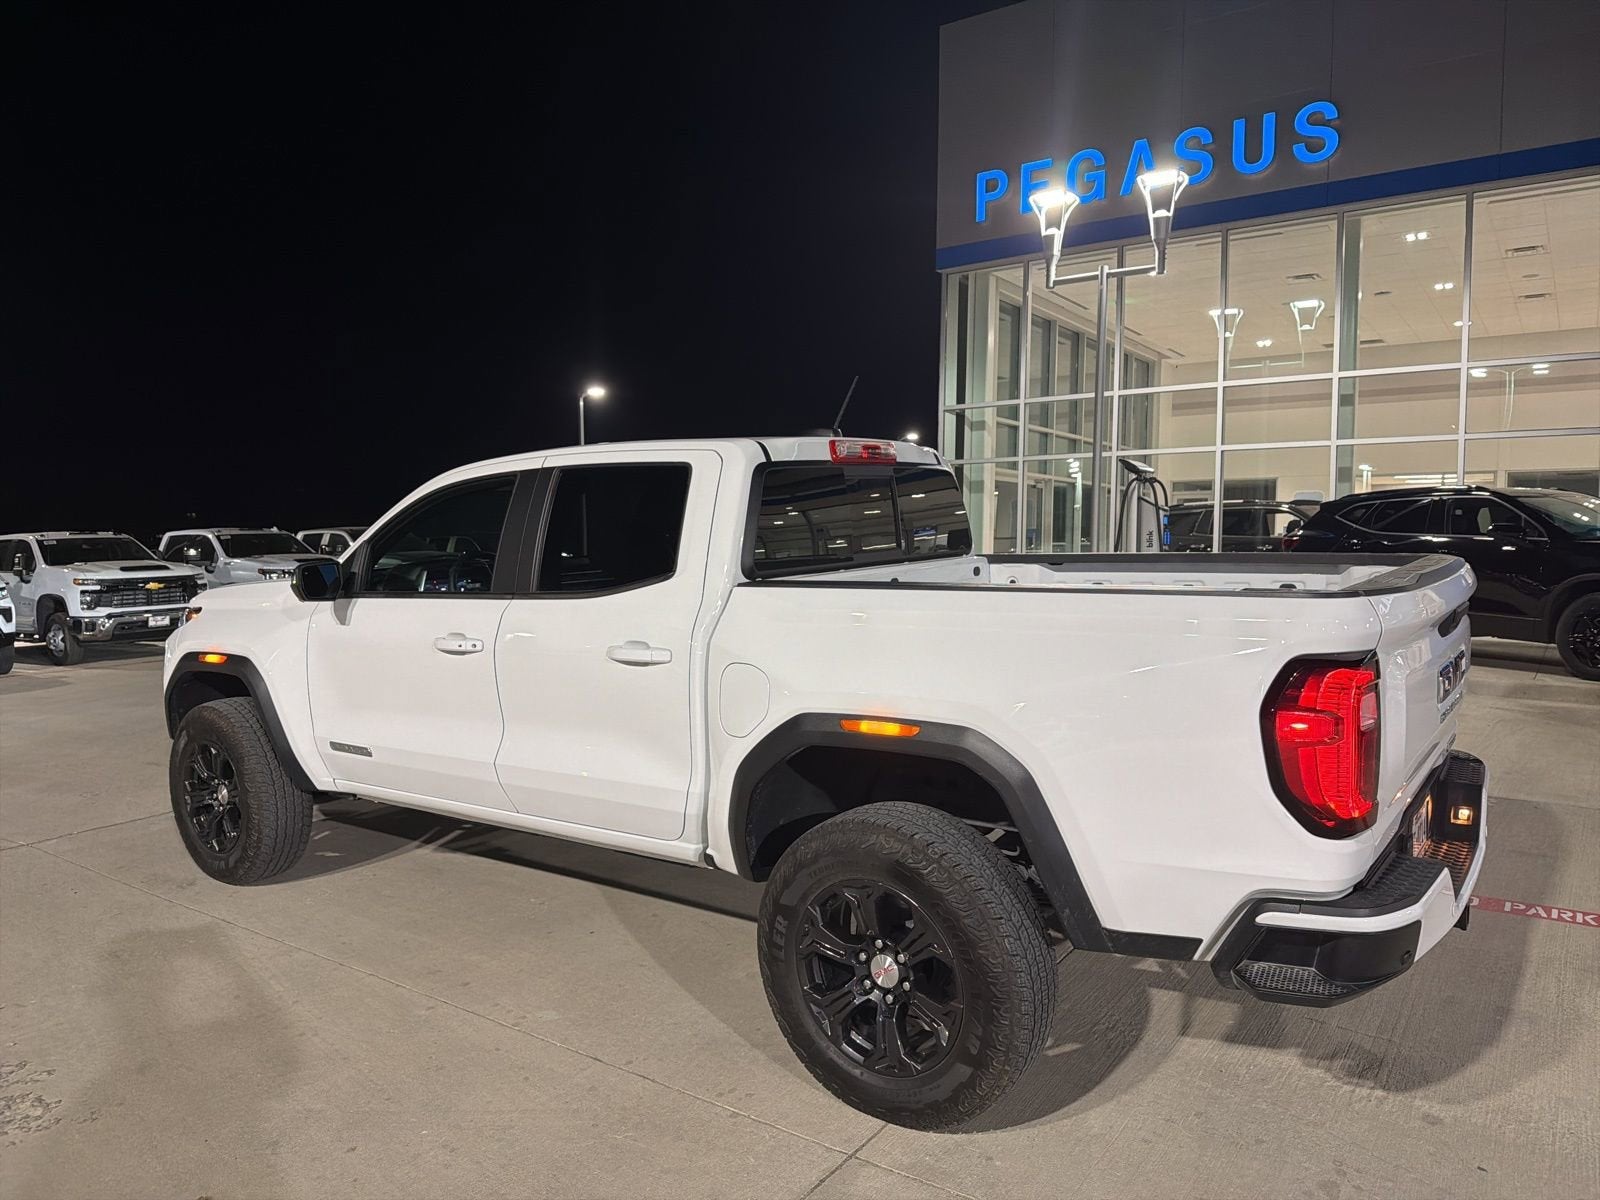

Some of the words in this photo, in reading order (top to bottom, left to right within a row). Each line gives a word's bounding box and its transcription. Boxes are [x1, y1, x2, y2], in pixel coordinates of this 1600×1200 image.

[975, 101, 1340, 223] PEGASUS
[1145, 530, 1154, 548] blink
[1504, 901, 1599, 926] PARK
[873, 965, 895, 979] GMC
